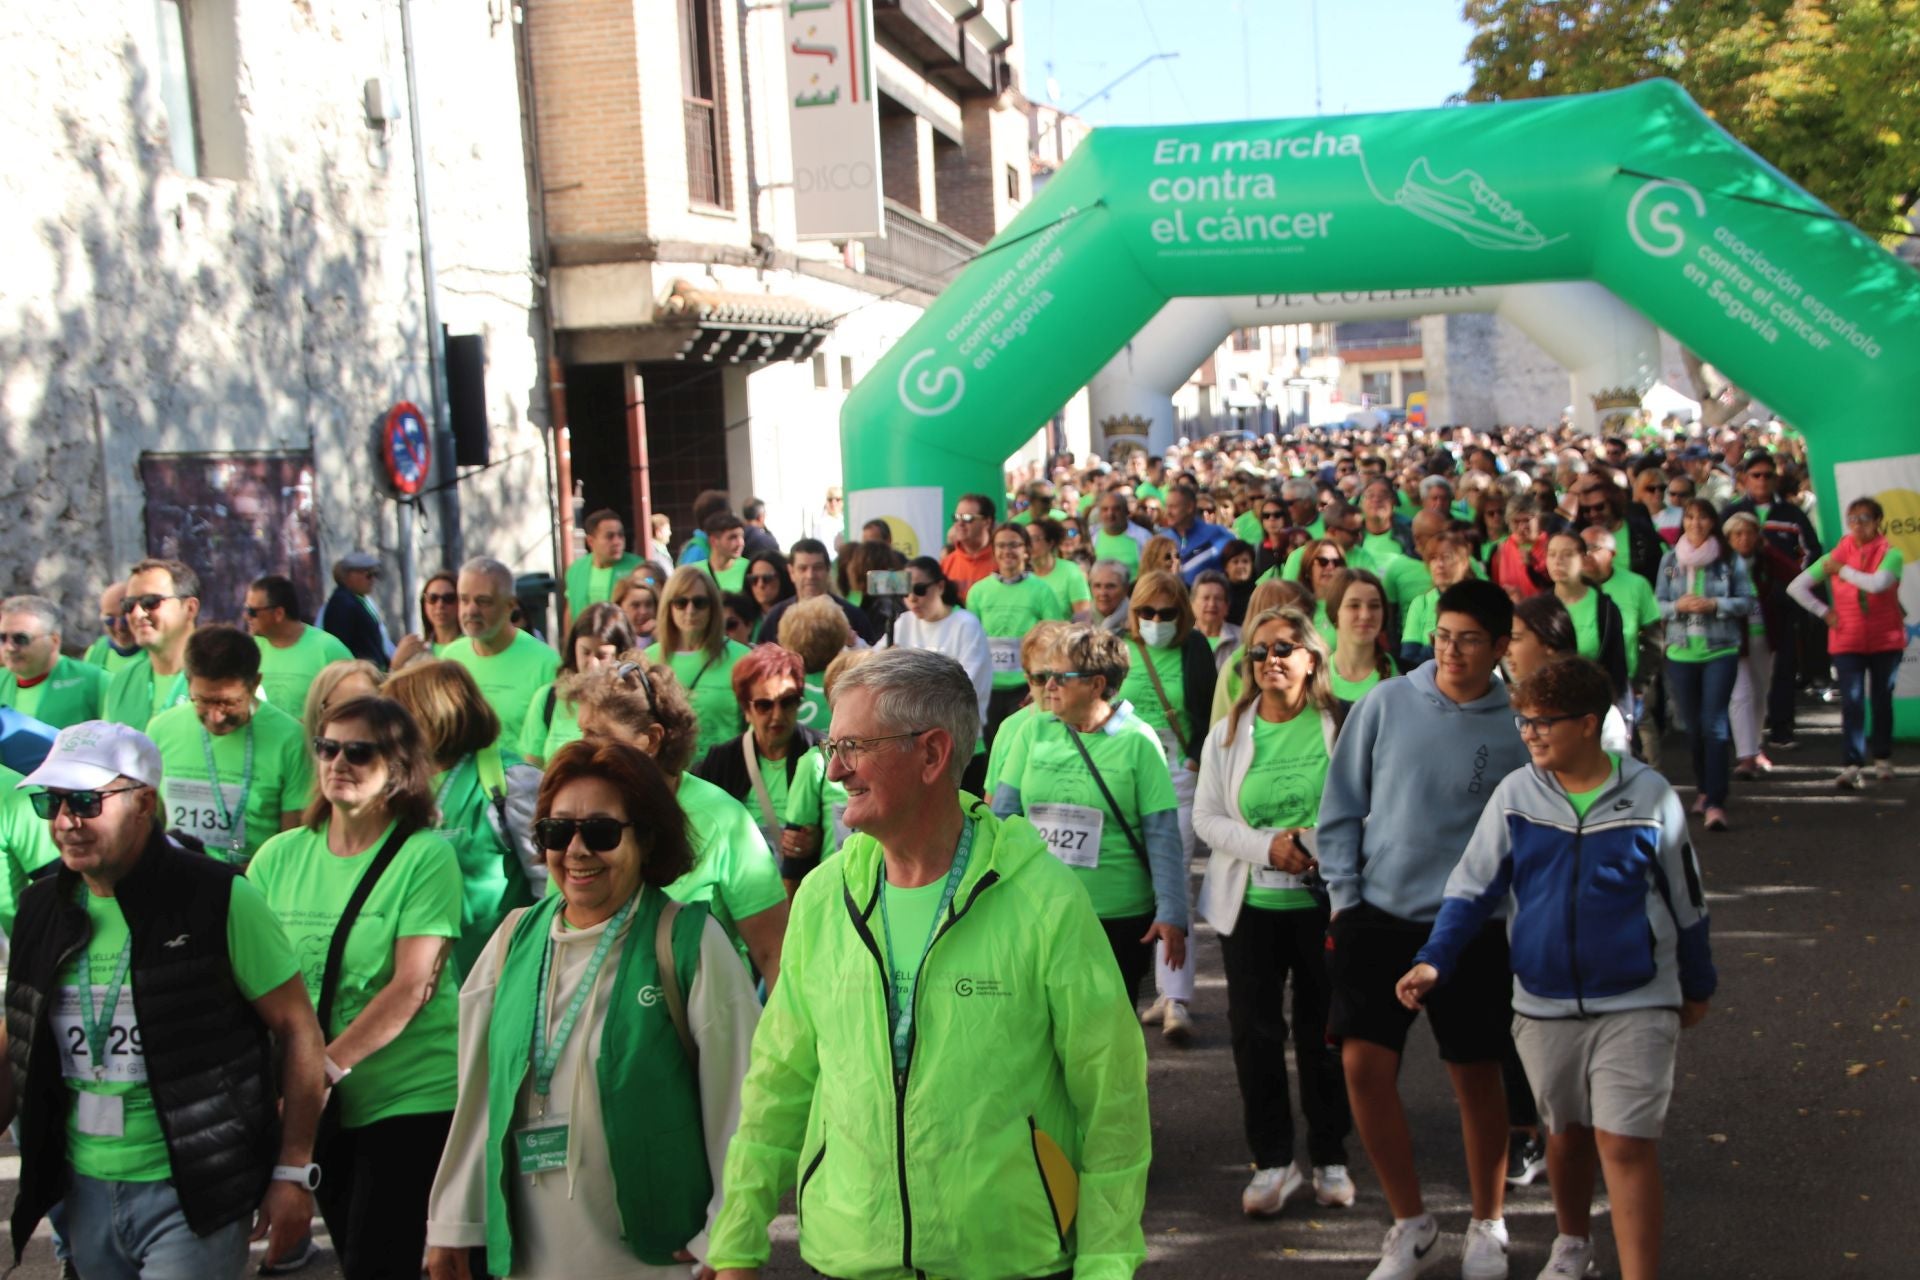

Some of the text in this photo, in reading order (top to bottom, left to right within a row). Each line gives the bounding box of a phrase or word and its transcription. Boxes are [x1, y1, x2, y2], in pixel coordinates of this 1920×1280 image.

[1154, 130, 1361, 165] En marcha
[796, 161, 873, 193] DISCO
[1148, 168, 1276, 203] contra
[1151, 206, 1333, 243] el cáncer
[946, 268, 1017, 341] asociación
[959, 246, 1065, 356] contra el cáncer
[1683, 262, 1779, 344] en Segovia
[1697, 243, 1832, 351] contra el cáncer
[1713, 225, 1881, 360] asociación española
[972, 289, 1054, 371] en Segovia
[991, 650, 1016, 664] 321
[174, 806, 232, 831] 2133
[1039, 827, 1089, 850] 2427
[67, 1025, 143, 1056] 229
